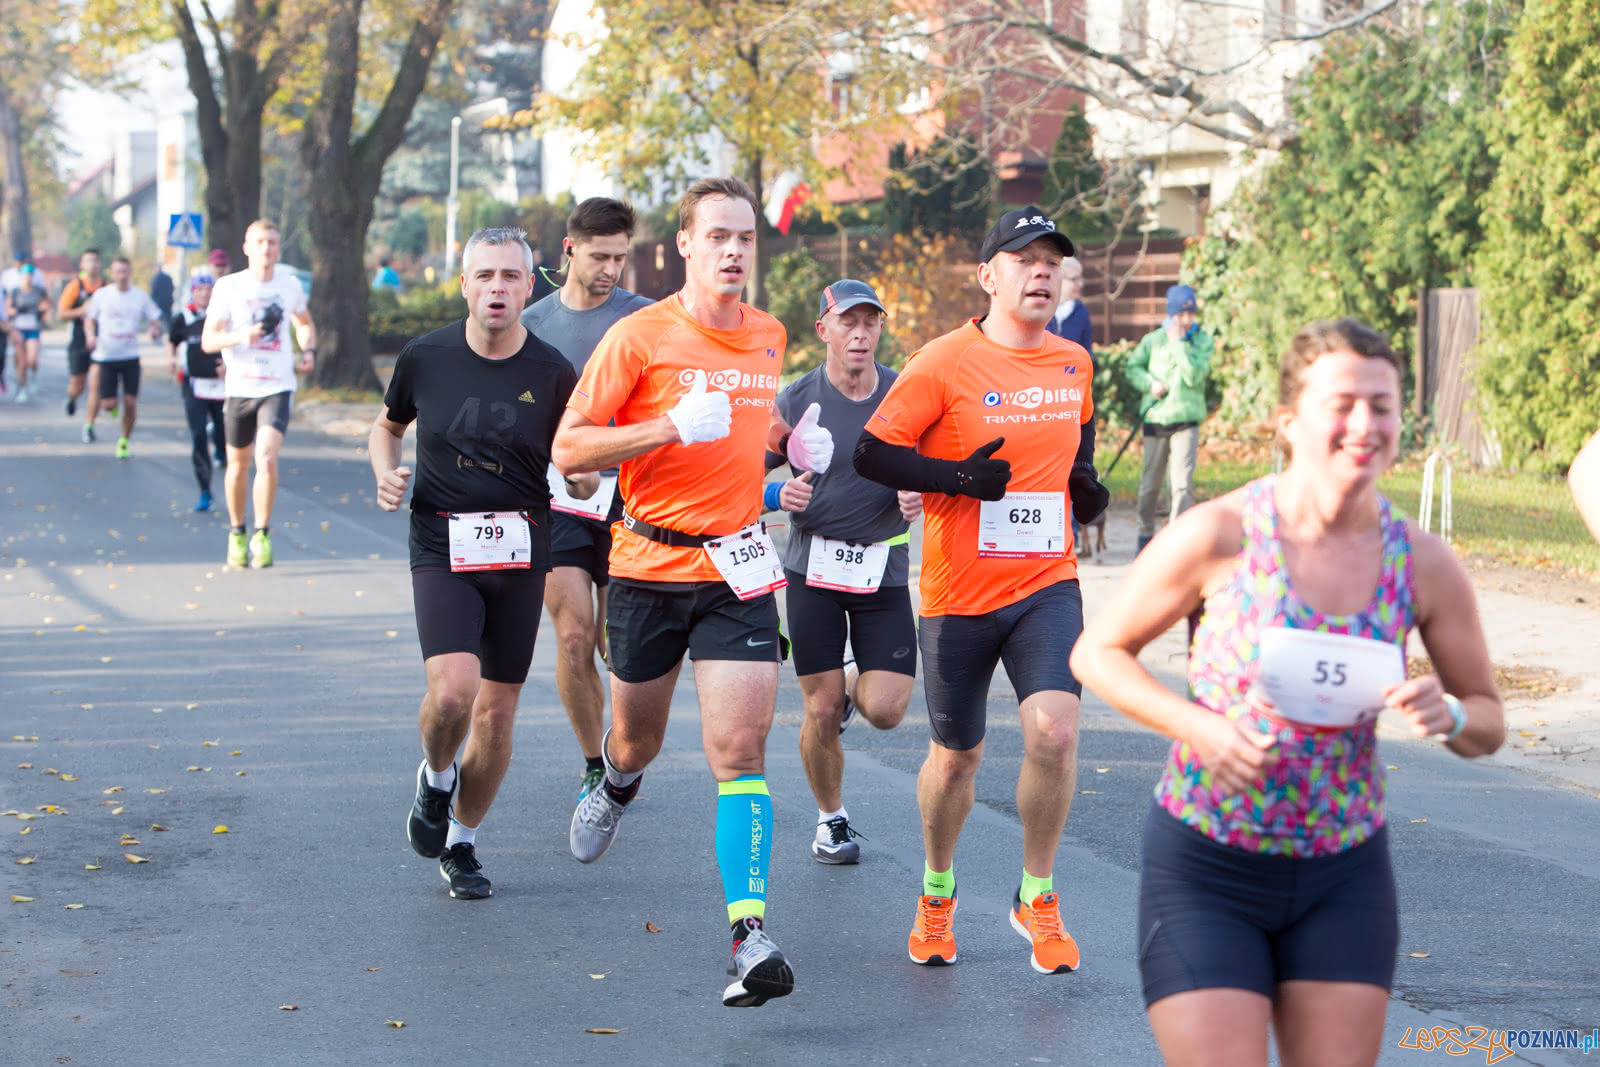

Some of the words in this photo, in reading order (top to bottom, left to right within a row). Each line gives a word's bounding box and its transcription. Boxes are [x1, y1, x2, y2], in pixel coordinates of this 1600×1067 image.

[1008, 508, 1042, 524] 628
[473, 526, 504, 540] 799
[729, 541, 766, 567] 1505
[835, 548, 864, 565] 938
[1312, 660, 1347, 686] 55
